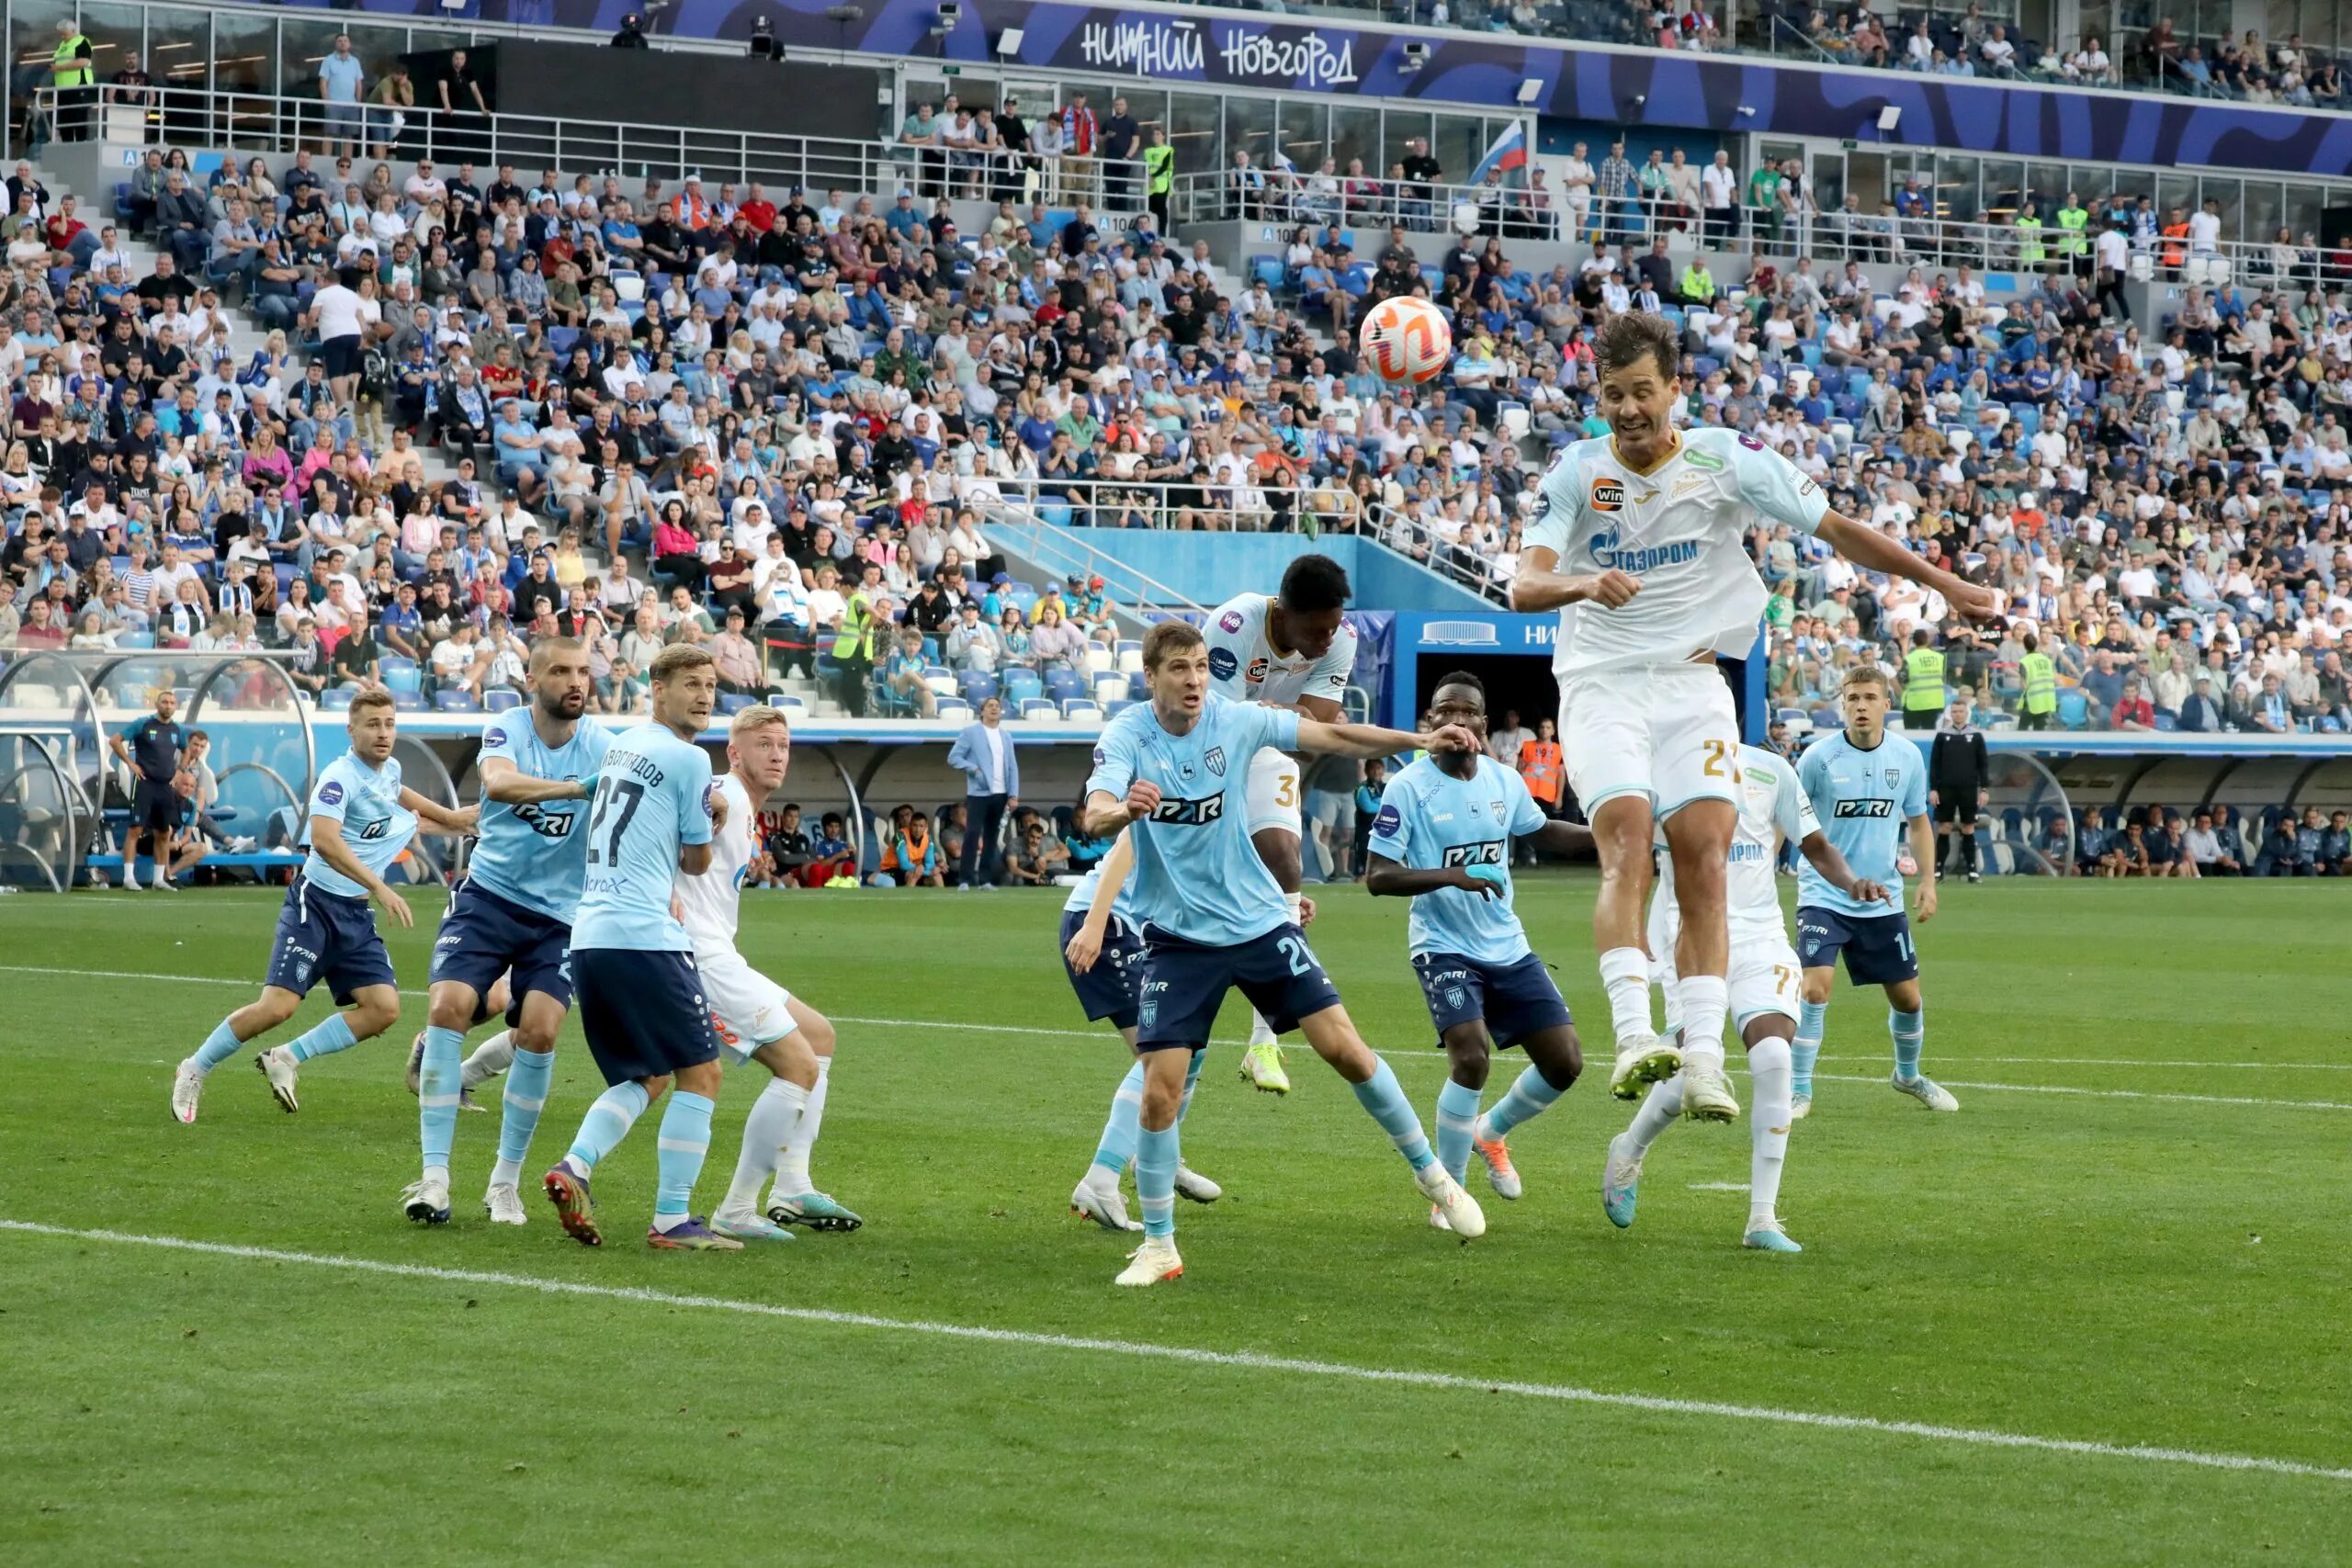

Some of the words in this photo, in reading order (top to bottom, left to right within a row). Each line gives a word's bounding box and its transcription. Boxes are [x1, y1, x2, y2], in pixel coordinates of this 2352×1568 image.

[1080, 20, 1204, 77] НИЖНИЙ
[1597, 489, 1623, 502] Win
[1613, 540, 1698, 571] ГАЗПРОМ
[1224, 615, 1241, 629] WB
[1525, 625, 1557, 645] НИ
[1274, 774, 1301, 814] 3
[1153, 796, 1224, 823] PAR
[1836, 800, 1893, 816] PARI
[587, 775, 645, 868] 27
[1443, 840, 1503, 868] PARI
[1728, 844, 1764, 862] ПРОМ
[1802, 923, 1828, 936] PARI
[1434, 970, 1467, 986] PARI
